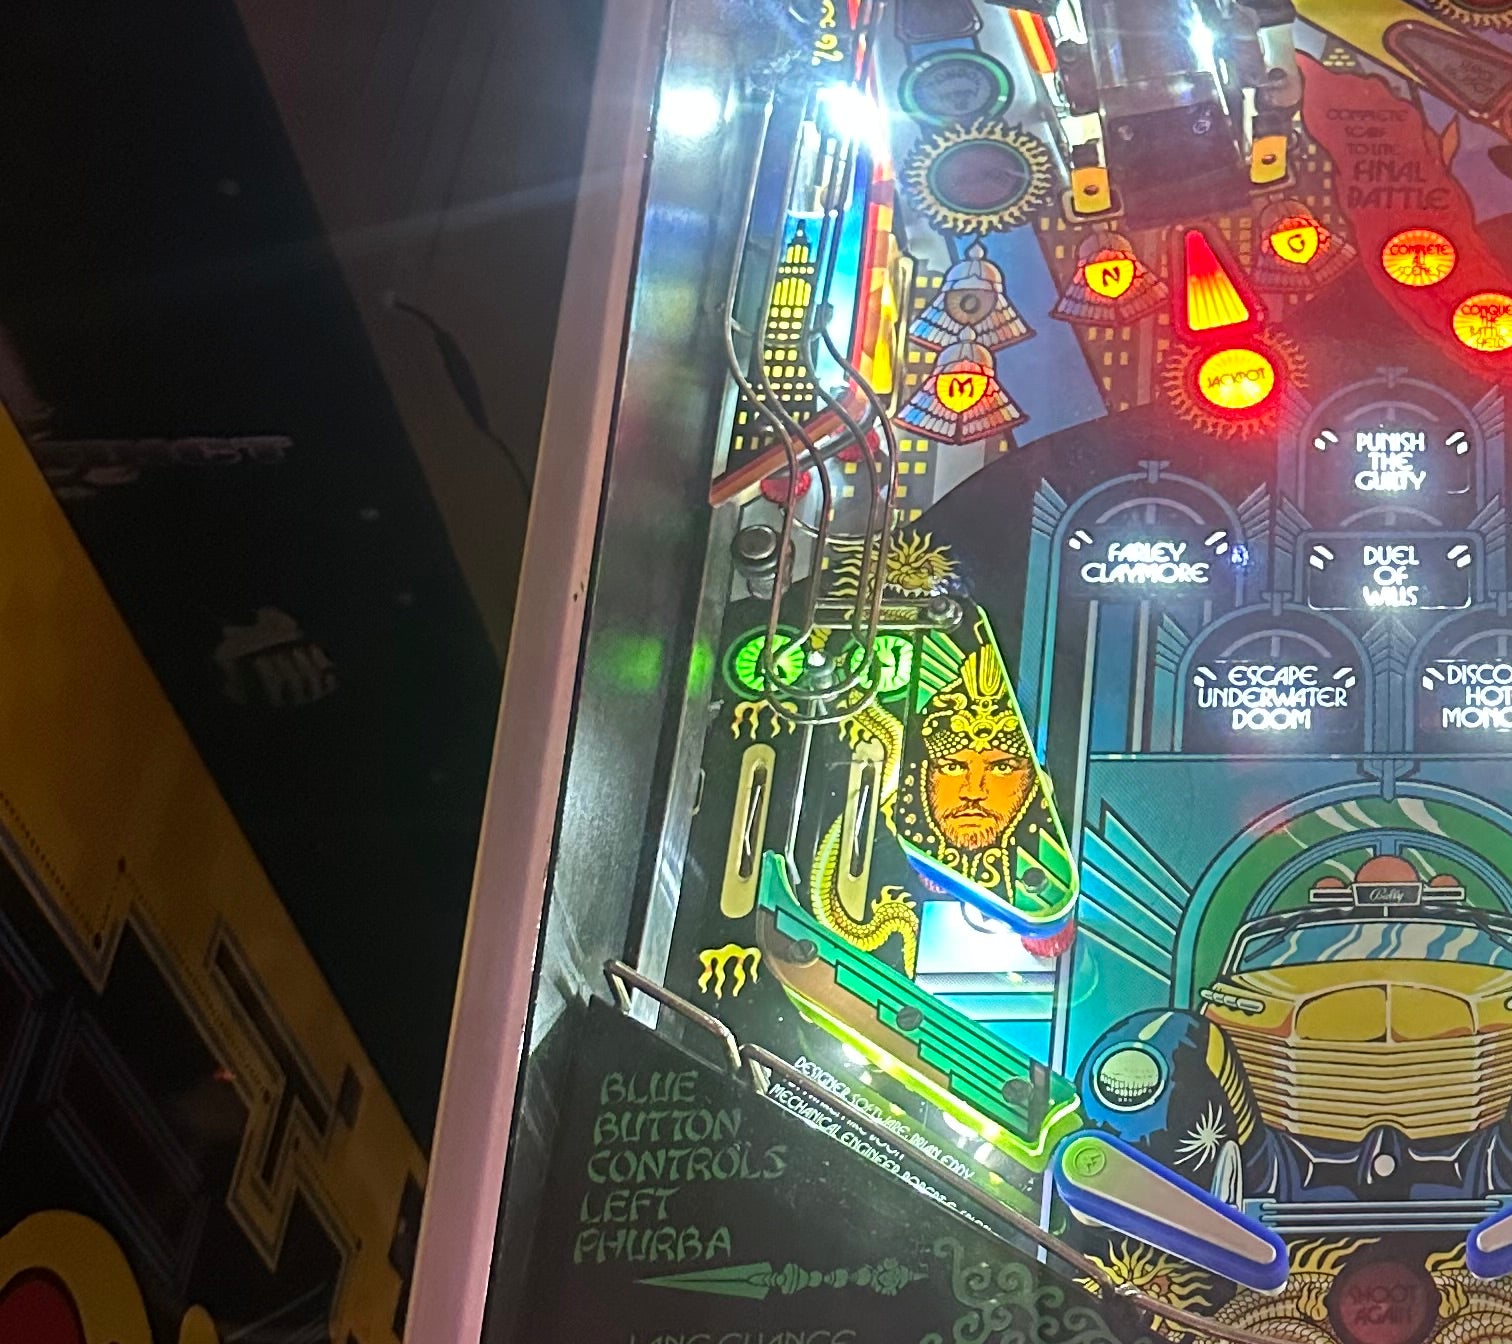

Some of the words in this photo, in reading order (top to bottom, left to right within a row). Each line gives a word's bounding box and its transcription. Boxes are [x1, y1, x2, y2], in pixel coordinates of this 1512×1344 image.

[1353, 159, 1428, 184] FINAL
[1345, 186, 1452, 212] BATTLE
[1207, 367, 1267, 391] JACKPOT
[1356, 432, 1425, 453] PUNISH
[1367, 452, 1414, 471] THE
[1363, 545, 1420, 566] DUEL
[1081, 562, 1210, 584] CLAYMORE
[1373, 566, 1409, 586] OF
[1228, 665, 1319, 686] ESCAPE
[1198, 686, 1348, 708] UNDERWATER
[1231, 708, 1312, 730] DOOM
[600, 1070, 699, 1105] BLUE
[593, 1108, 741, 1145] BUTTON
[769, 1083, 842, 1136] MECHANICAL
[840, 1130, 902, 1176] ENGINEER
[587, 1144, 788, 1185] CONTROLS
[940, 1153, 975, 1181] EDDY
[579, 1187, 681, 1224] LEFT
[573, 1225, 732, 1264] PHURBA
